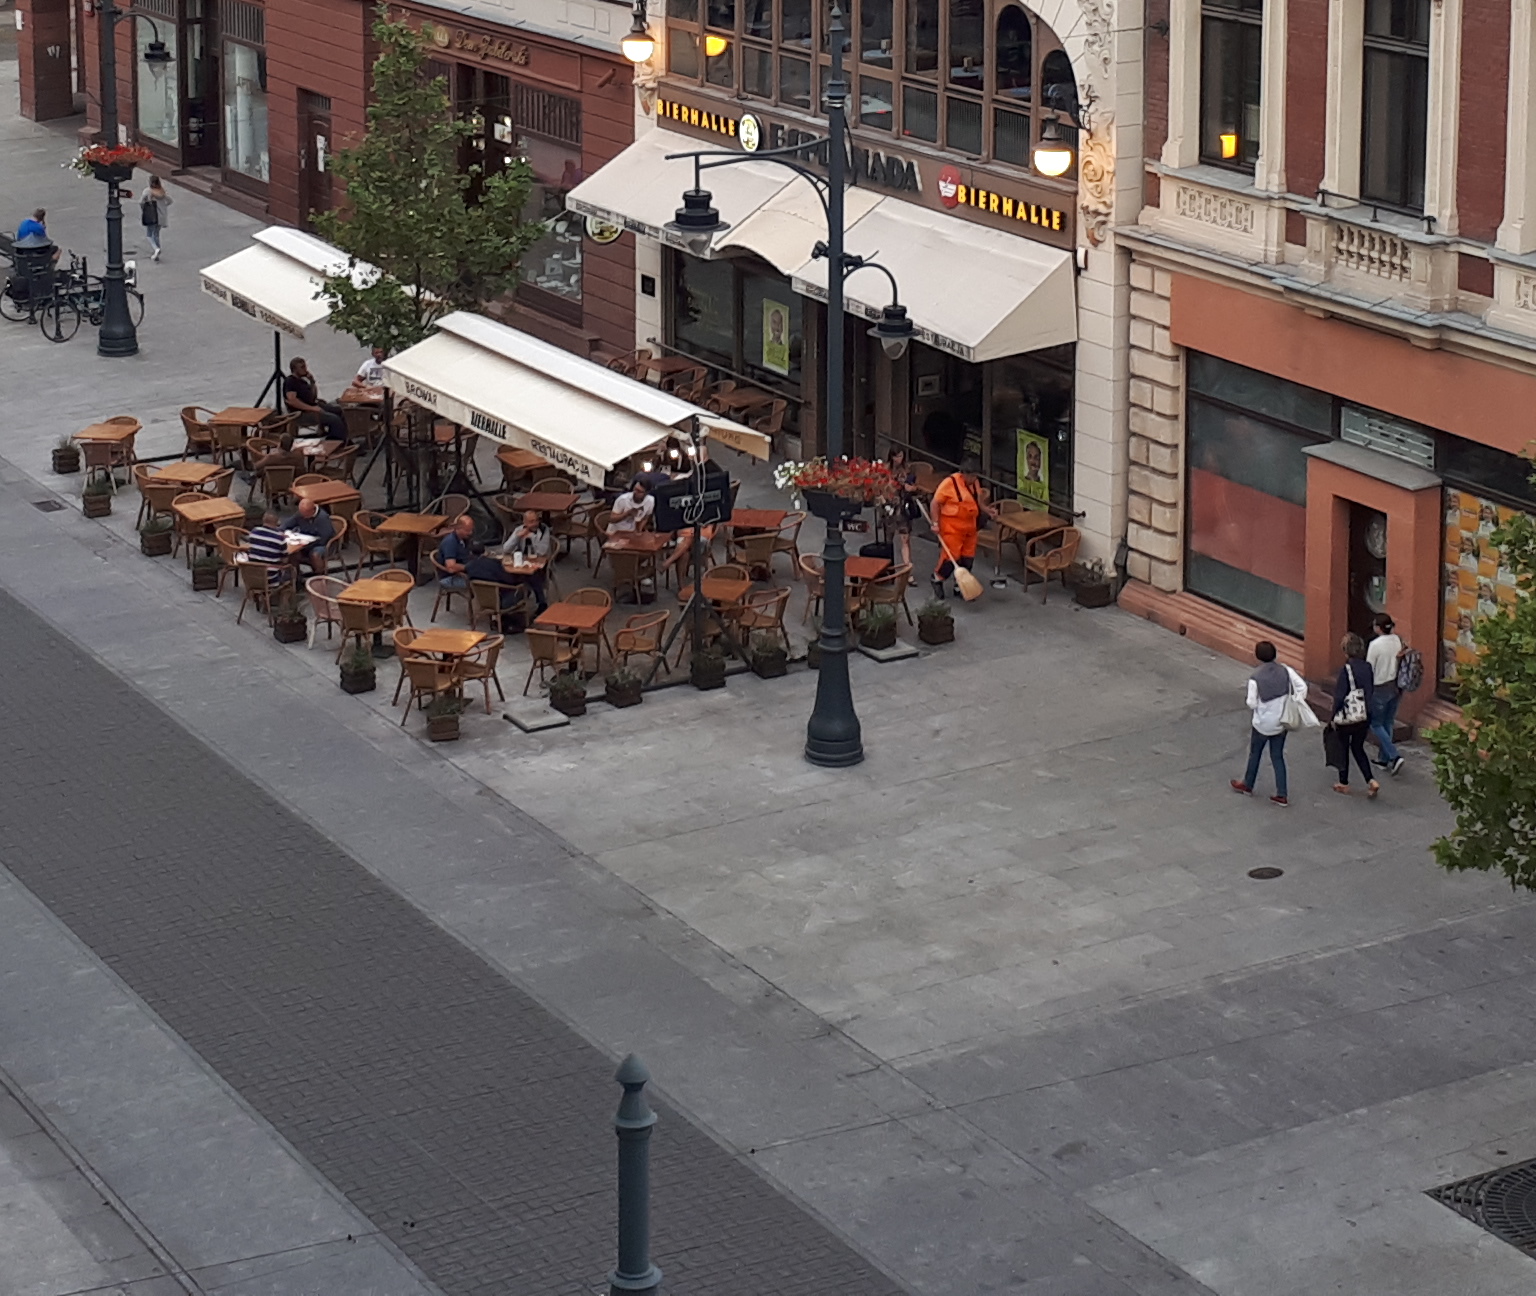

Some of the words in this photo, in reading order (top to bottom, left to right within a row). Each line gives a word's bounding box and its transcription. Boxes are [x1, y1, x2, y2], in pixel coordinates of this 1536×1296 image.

[657, 98, 736, 137] BIERHALLE
[957, 184, 1062, 231] BIERHALLE
[405, 381, 438, 405] BROWAR
[471, 410, 507, 440] BIERHALLE
[847, 523, 862, 531] WC
